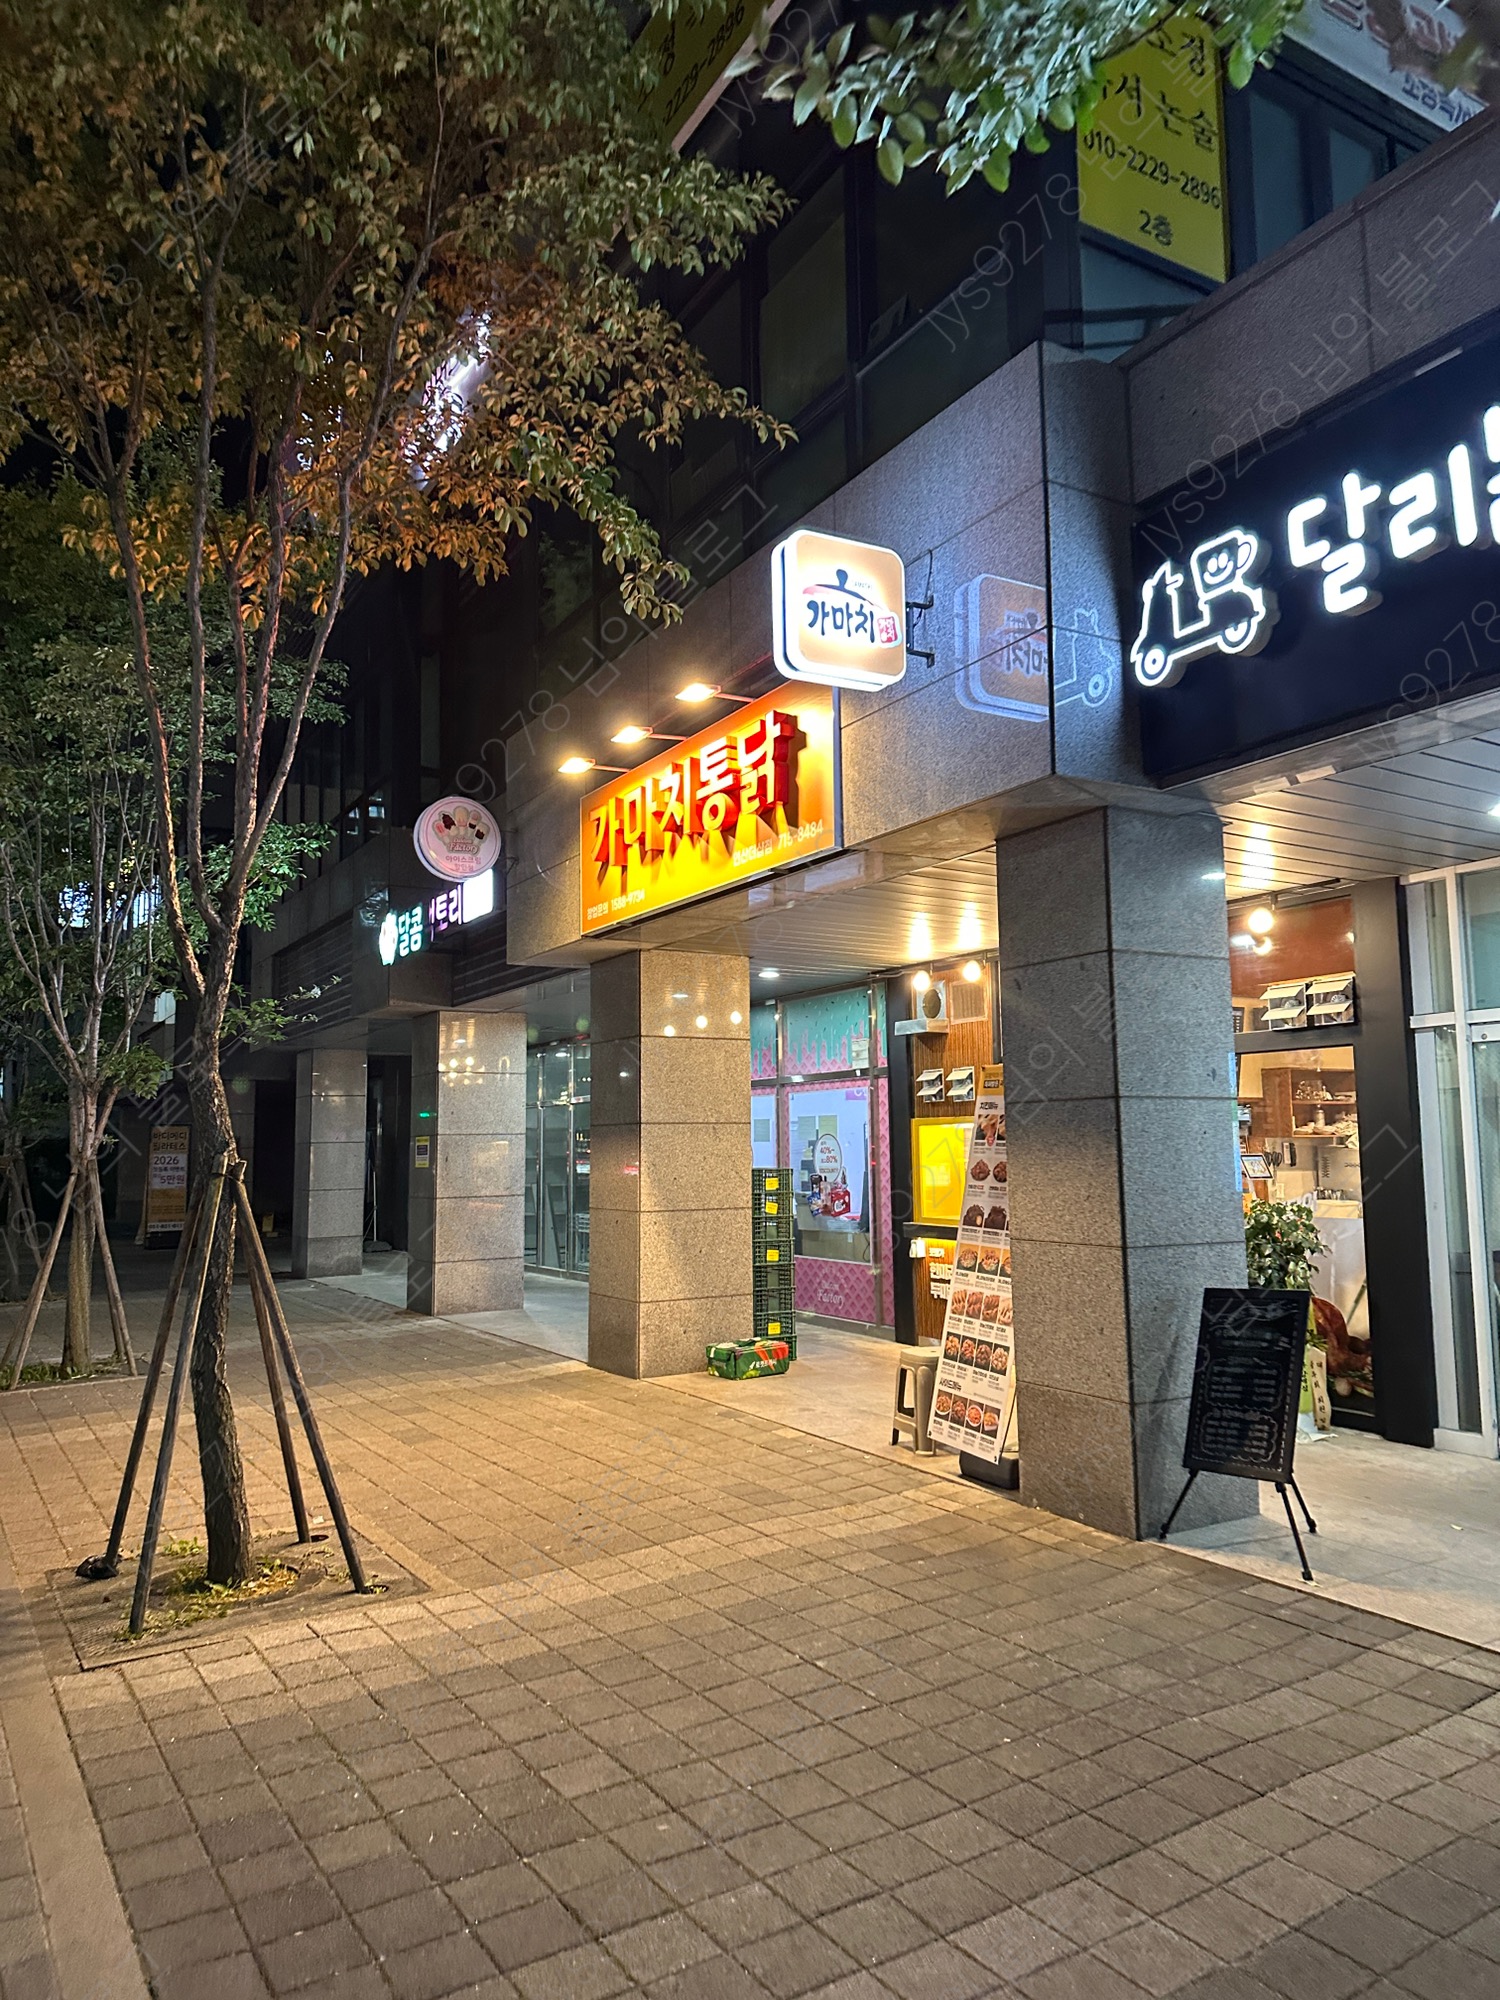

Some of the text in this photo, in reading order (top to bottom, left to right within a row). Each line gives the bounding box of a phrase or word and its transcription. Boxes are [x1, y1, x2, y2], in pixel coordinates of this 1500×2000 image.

[1083, 130, 1222, 210] 010-2229-2896
[1138, 209, 1173, 247] 2층
[1287, 404, 1500, 614] 달리
[806, 599, 875, 643] 가마치
[589, 709, 794, 866] 가마치통닭
[450, 842, 479, 855] Factory
[778, 819, 824, 851] 715-8484
[445, 855, 482, 866] 아이스크림
[611, 887, 646, 912] 1588-9734
[398, 905, 424, 957] 달콤
[152, 1142, 187, 1152] 필라테스
[153, 1155, 179, 1165] 2026
